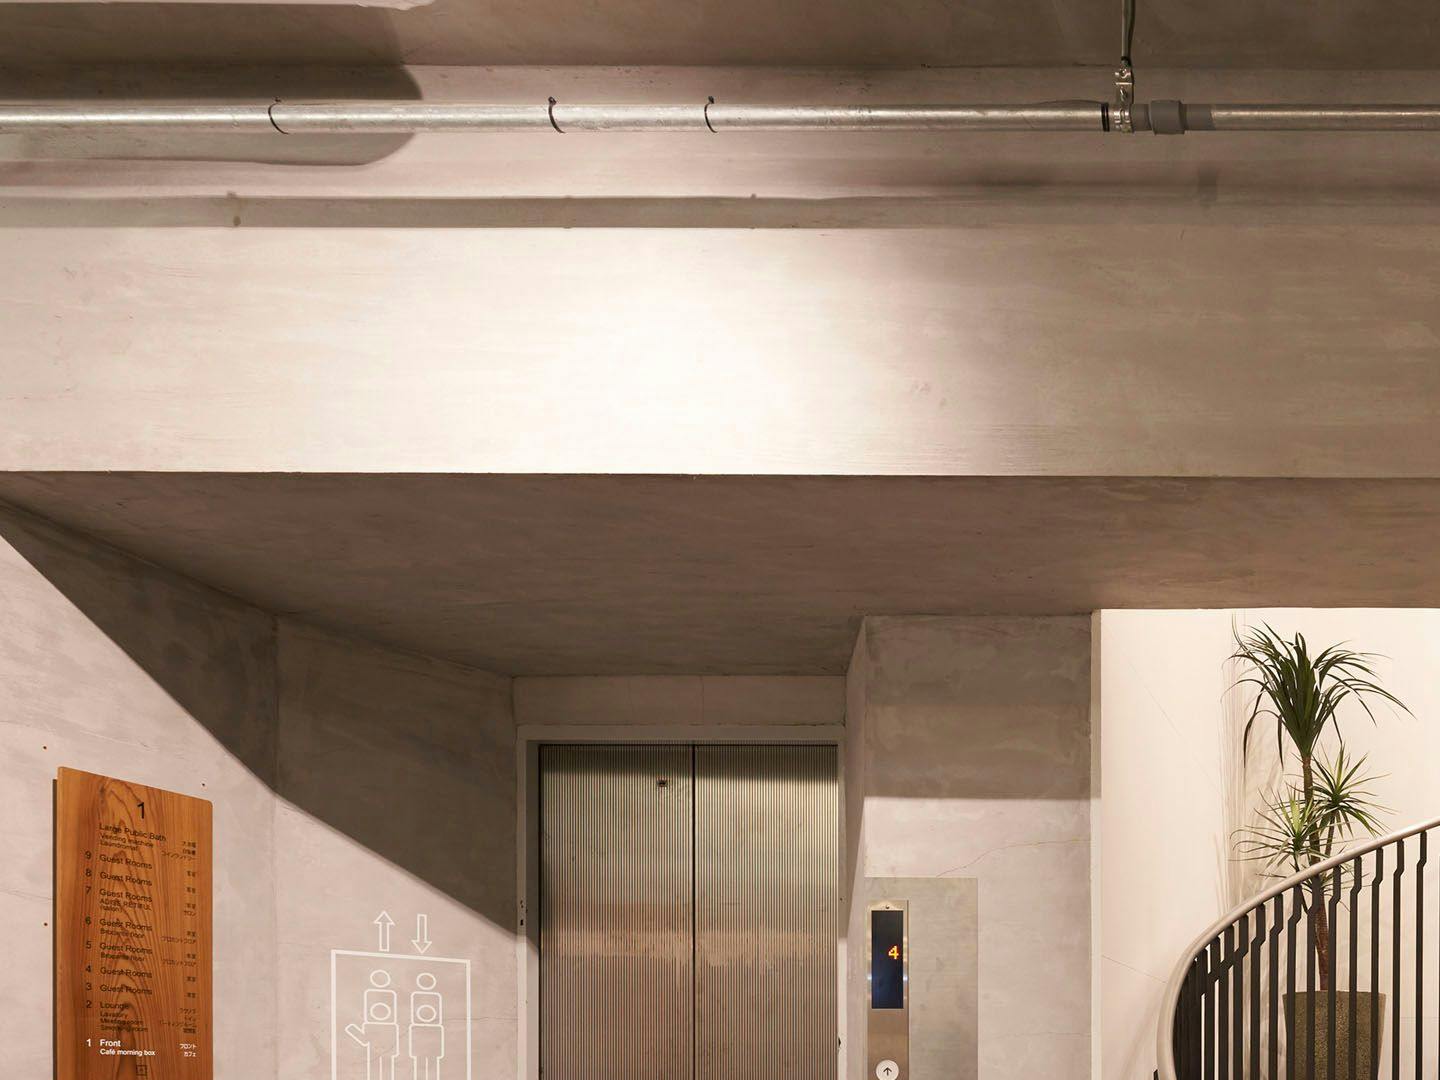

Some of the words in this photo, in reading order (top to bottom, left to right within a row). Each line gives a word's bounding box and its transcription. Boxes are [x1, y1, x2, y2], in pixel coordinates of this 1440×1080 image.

[137, 802, 145, 819] 1
[99, 822, 122, 834] Large
[124, 826, 148, 839] Public
[149, 832, 167, 842] Bath
[84, 850, 92, 860] 9
[99, 854, 122, 865] Guest
[125, 859, 153, 870] Rooms
[84, 868, 92, 878] 8
[99, 871, 123, 881] Guest
[125, 875, 153, 886] Rooms
[84, 885, 92, 895] 7
[99, 888, 123, 898] Guest
[125, 891, 153, 903] Rooms
[84, 916, 92, 926] 6
[99, 918, 123, 928] Guest
[125, 921, 153, 932] Rooms
[85, 940, 92, 949] 5
[99, 942, 123, 952] Guest
[125, 945, 153, 955] Rooms
[887, 945, 900, 960] 4
[85, 965, 92, 973] 4
[100, 966, 123, 976] Guest
[125, 969, 153, 979] Rooms
[85, 982, 92, 991] 3
[100, 984, 123, 993] Guest
[125, 986, 153, 995] Rooms
[86, 1000, 92, 1009] 2
[100, 1001, 129, 1011] Lounge
[86, 1039, 92, 1047] 1
[99, 1039, 121, 1047] Front
[99, 1048, 116, 1056] Café
